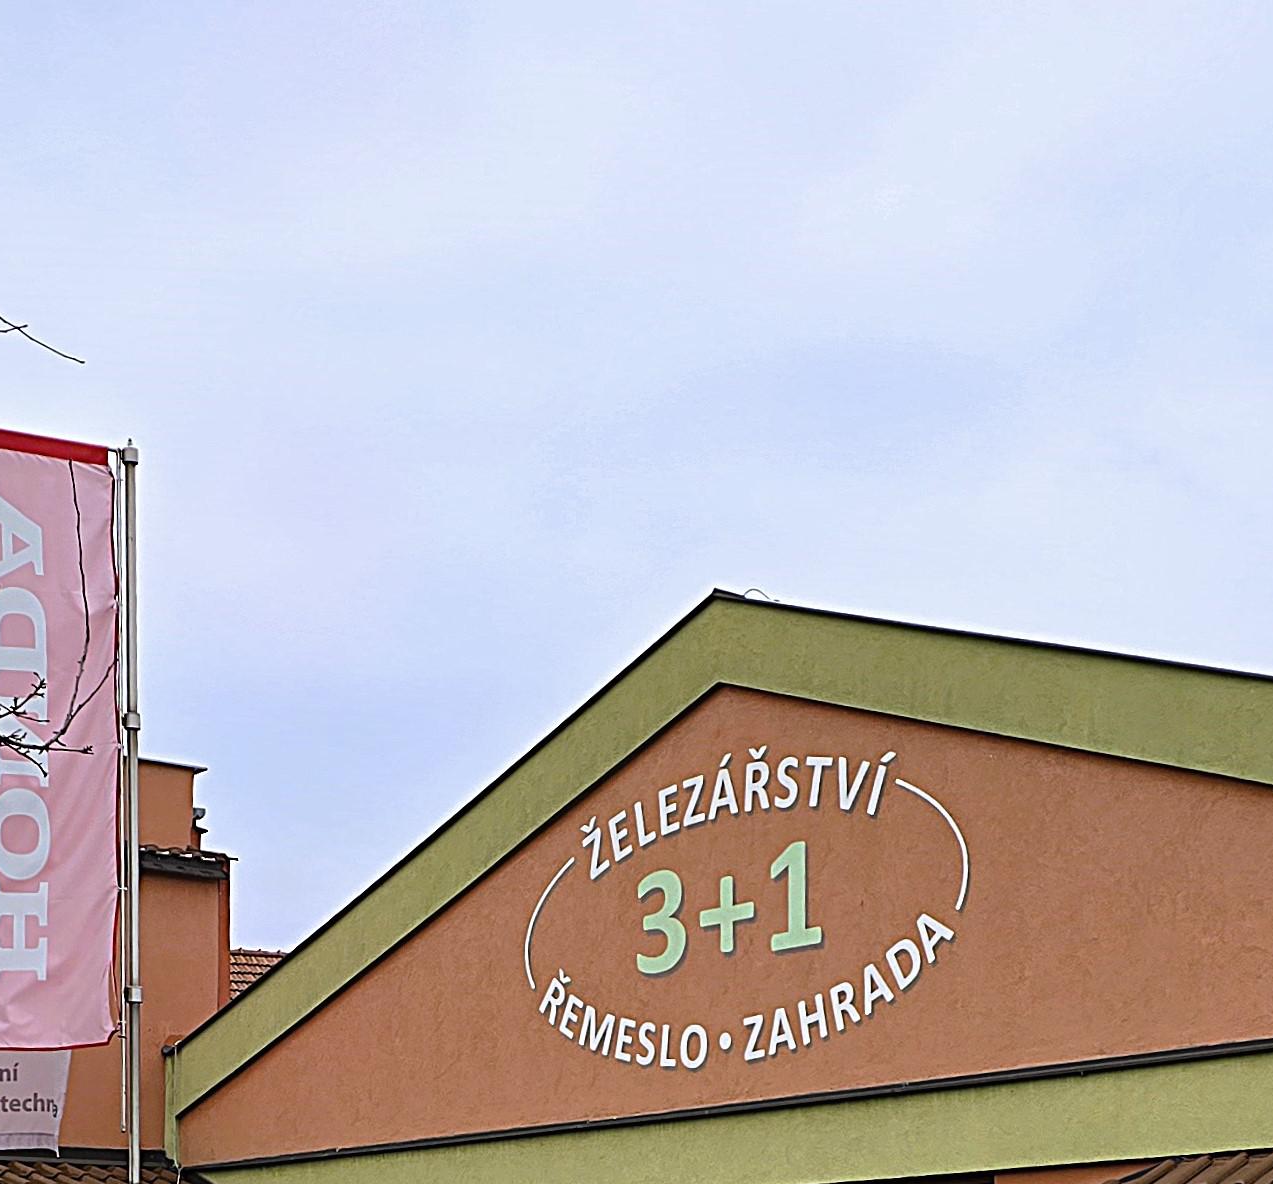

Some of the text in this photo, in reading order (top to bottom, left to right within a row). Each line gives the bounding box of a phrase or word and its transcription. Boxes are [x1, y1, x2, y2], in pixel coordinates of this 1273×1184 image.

[580, 745, 896, 880] ŽELEZÁŘSTVÍ
[636, 840, 822, 975] 3+1
[538, 912, 955, 1069] ŘEMESLO ZAHRADA
